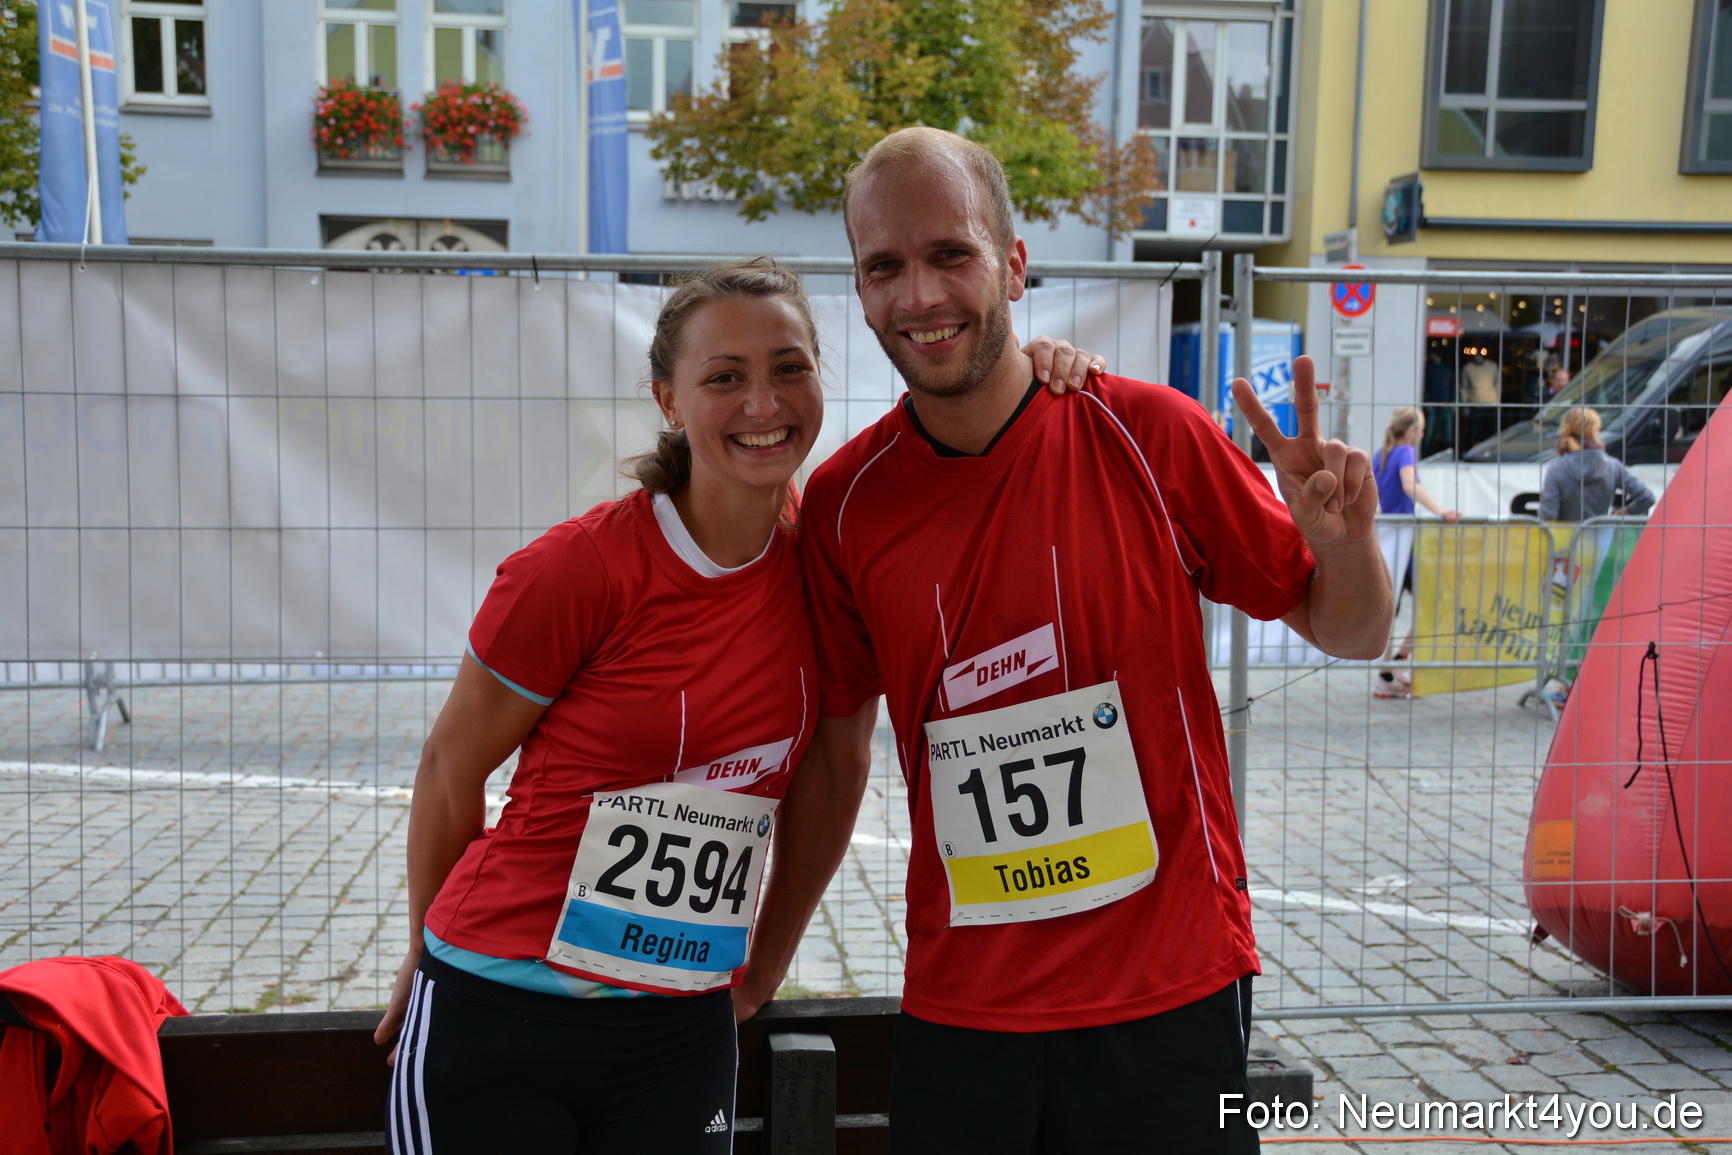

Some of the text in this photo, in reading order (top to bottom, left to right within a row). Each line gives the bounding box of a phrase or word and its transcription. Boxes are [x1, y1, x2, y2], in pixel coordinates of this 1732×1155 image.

[976, 648, 1026, 688] DEHN
[930, 715, 1086, 762] PARTL Neumarkt
[705, 756, 763, 781] DEHN
[597, 795, 754, 833] PARTL Neumarkt
[957, 746, 1087, 844] 157
[594, 824, 754, 915] 2594
[993, 855, 1091, 893] Tobias
[619, 922, 711, 964] Regina
